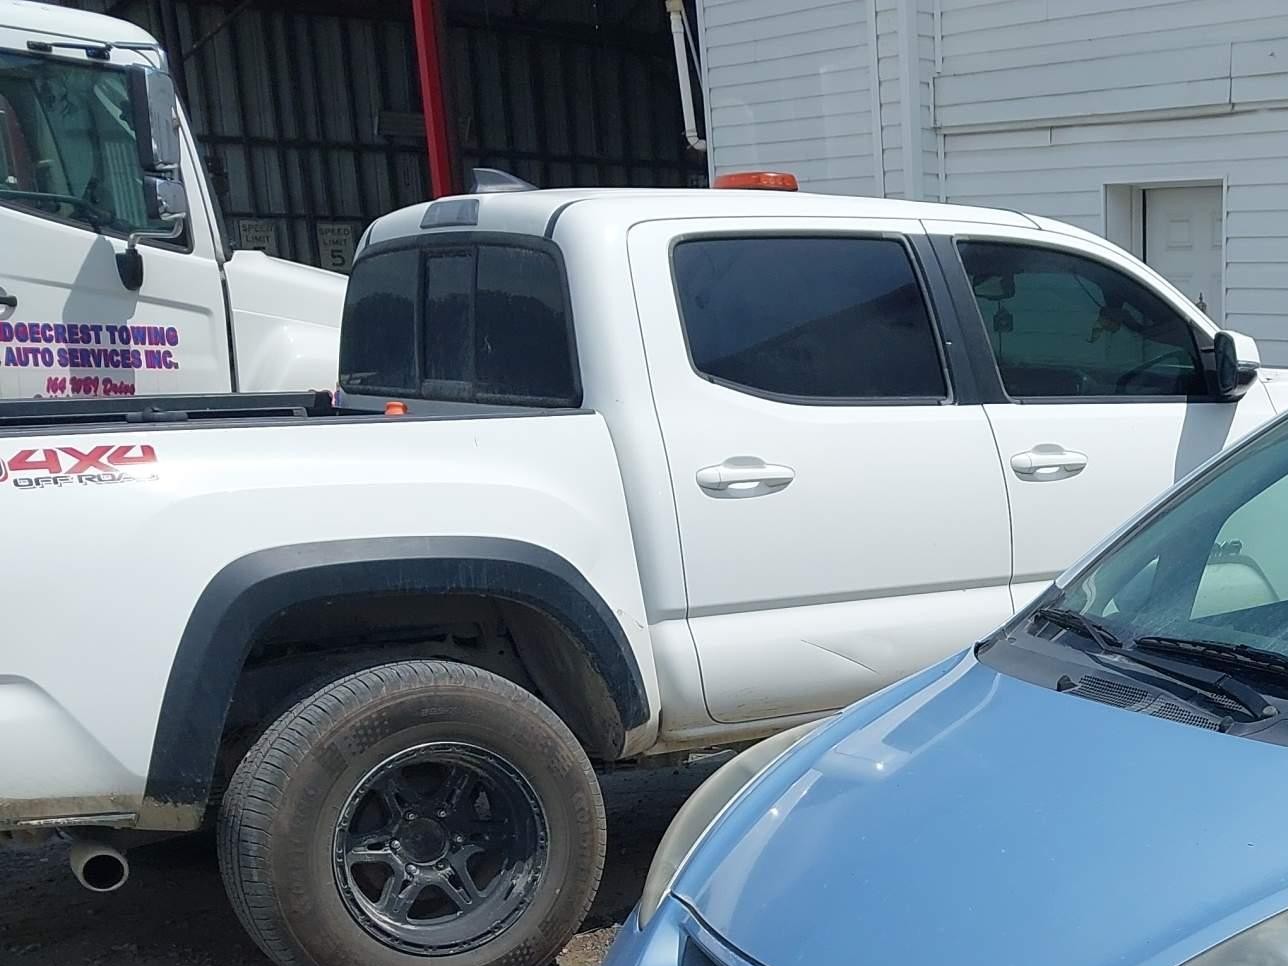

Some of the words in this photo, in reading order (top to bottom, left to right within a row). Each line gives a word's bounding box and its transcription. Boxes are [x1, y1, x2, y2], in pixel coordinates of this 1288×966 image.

[319, 227, 350, 236] SPEED
[246, 234, 270, 243] LIMIT
[323, 239, 348, 247] LIMIT
[330, 249, 346, 267] 5
[4, 346, 54, 368] AUTO
[57, 347, 143, 369] SERVICES
[145, 350, 179, 369] INC.
[12, 475, 72, 490] OFF
